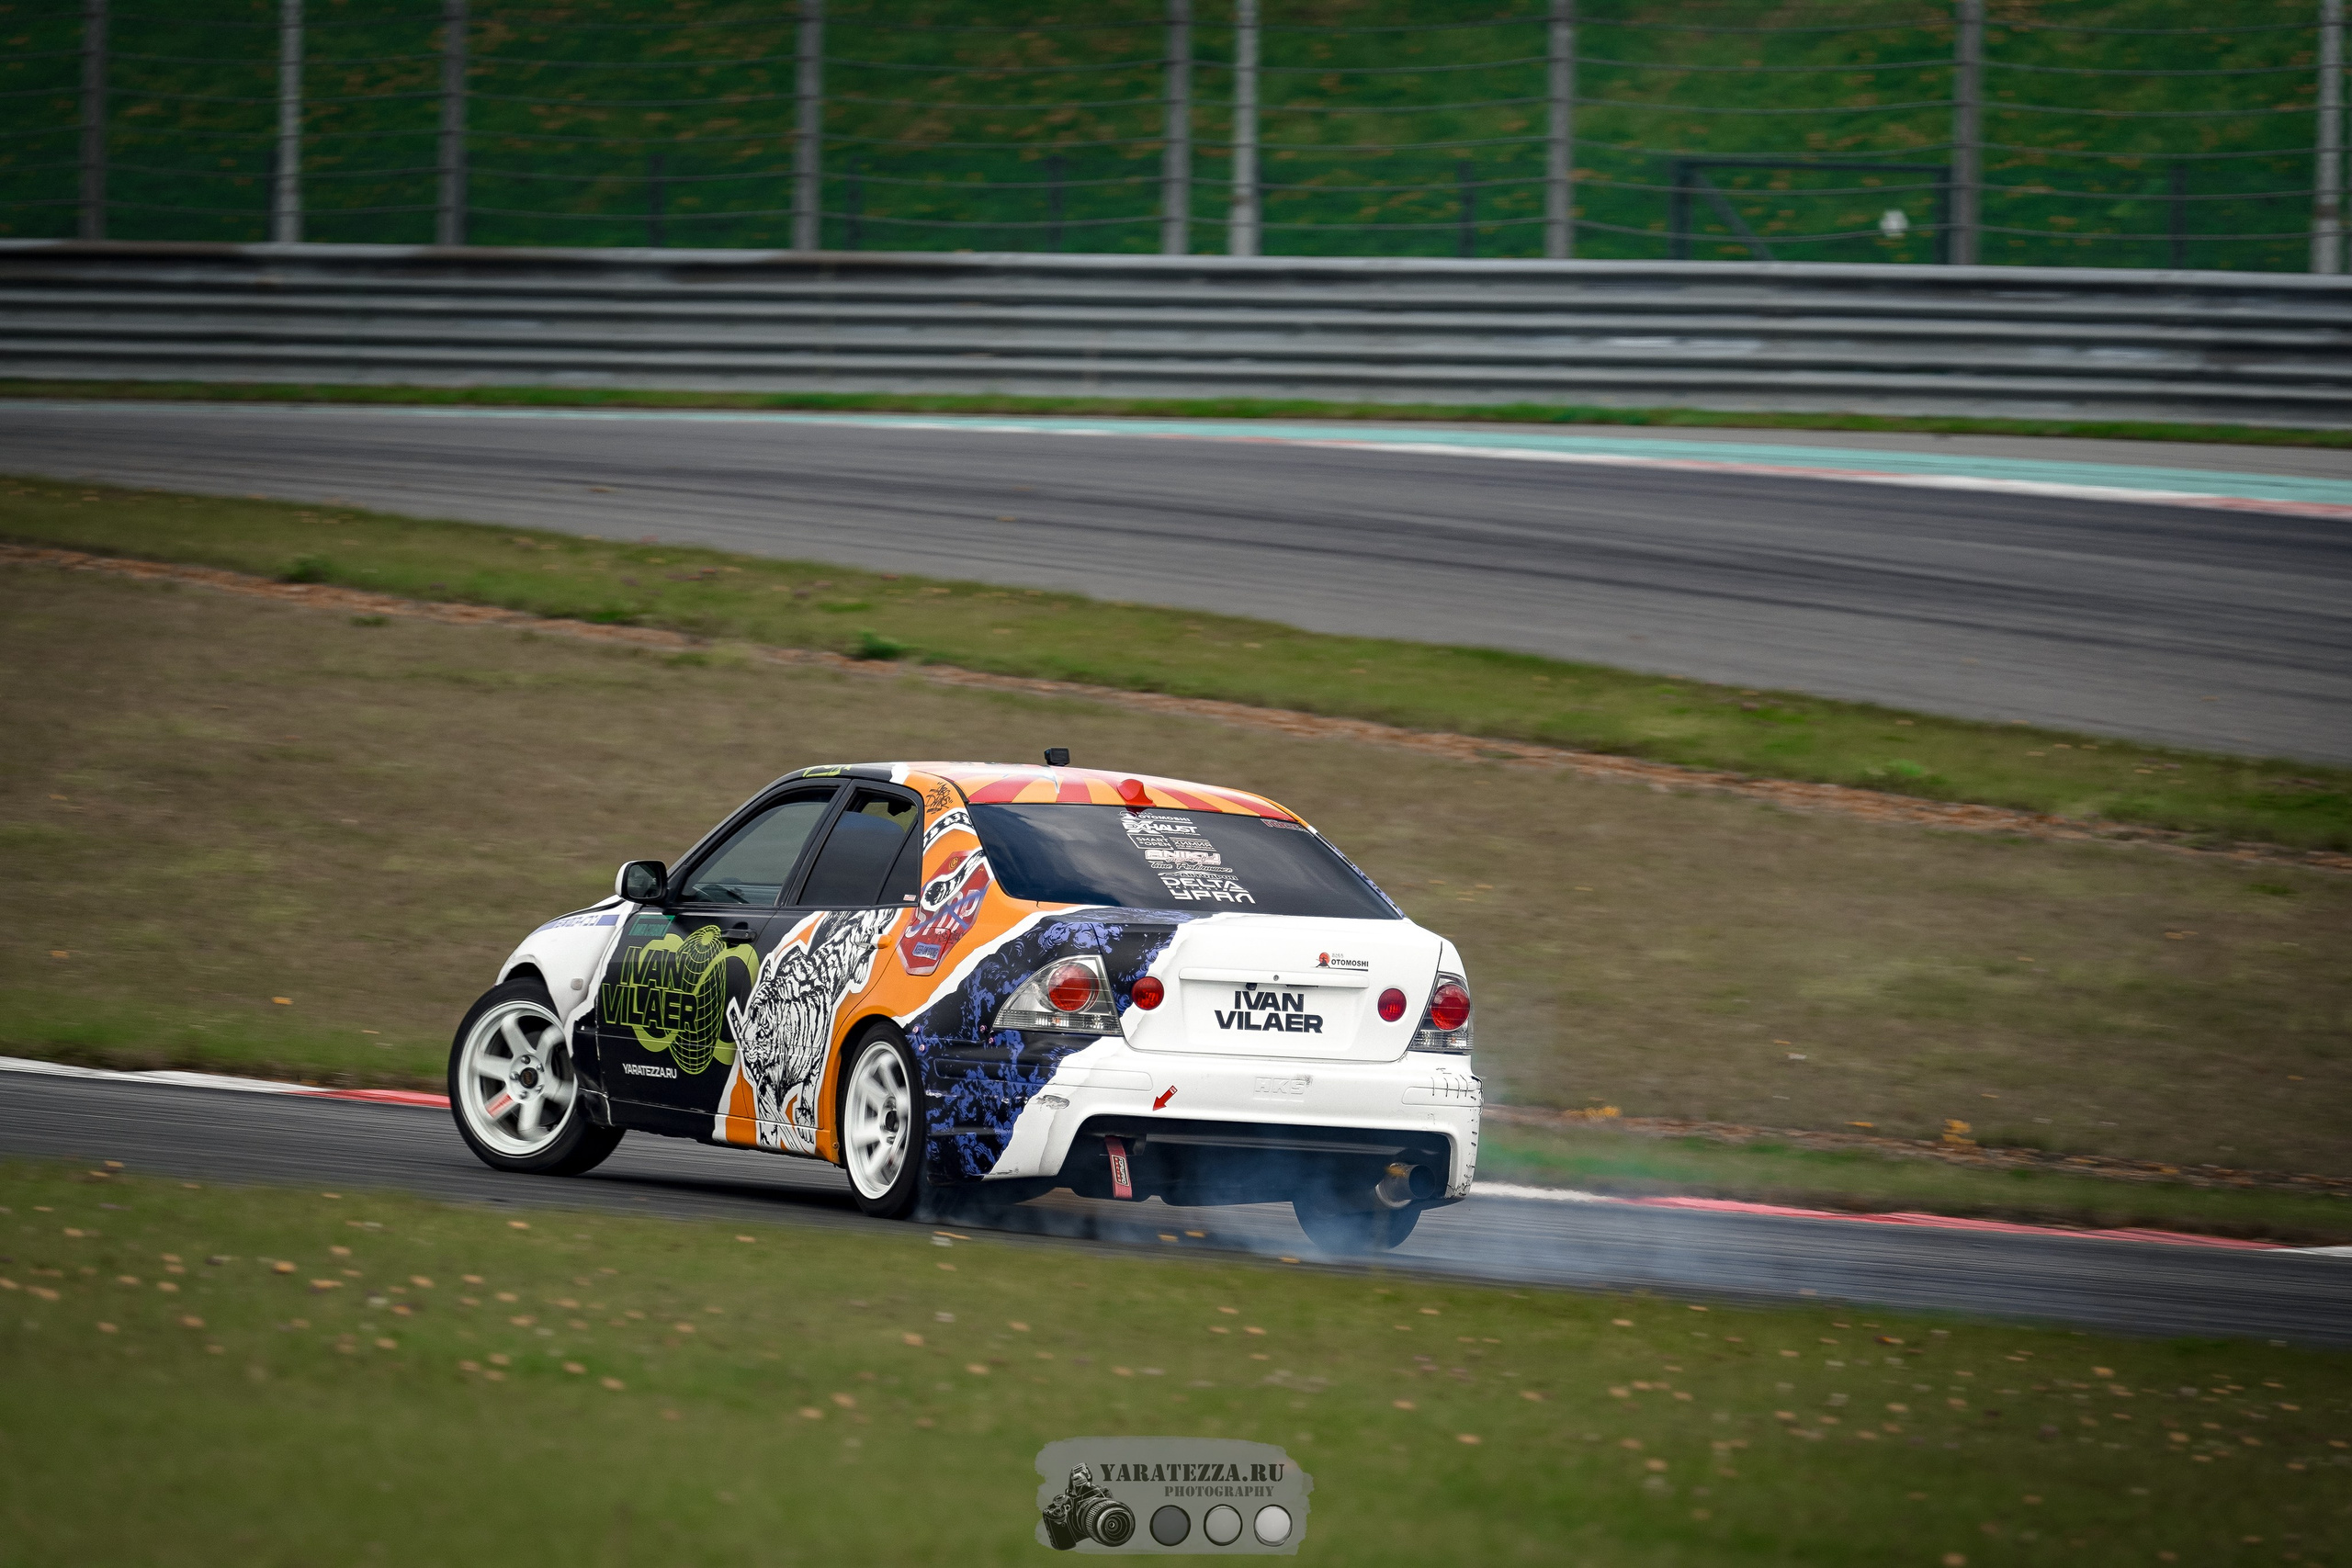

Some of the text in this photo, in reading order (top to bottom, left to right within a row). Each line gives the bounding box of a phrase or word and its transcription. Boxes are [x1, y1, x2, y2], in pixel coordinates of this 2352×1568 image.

[1121, 819, 1198, 835] EXHAUST
[1160, 876, 1250, 893] DELTA
[620, 945, 689, 992] IVAN
[1330, 958, 1369, 967] OTOMOSHI
[602, 982, 698, 1034] VILAER
[1234, 990, 1305, 1012] IVAN
[1214, 1010, 1324, 1033] VILAER
[622, 1063, 678, 1079] YARATEZZA.RU
[1254, 1077, 1306, 1097] HKS
